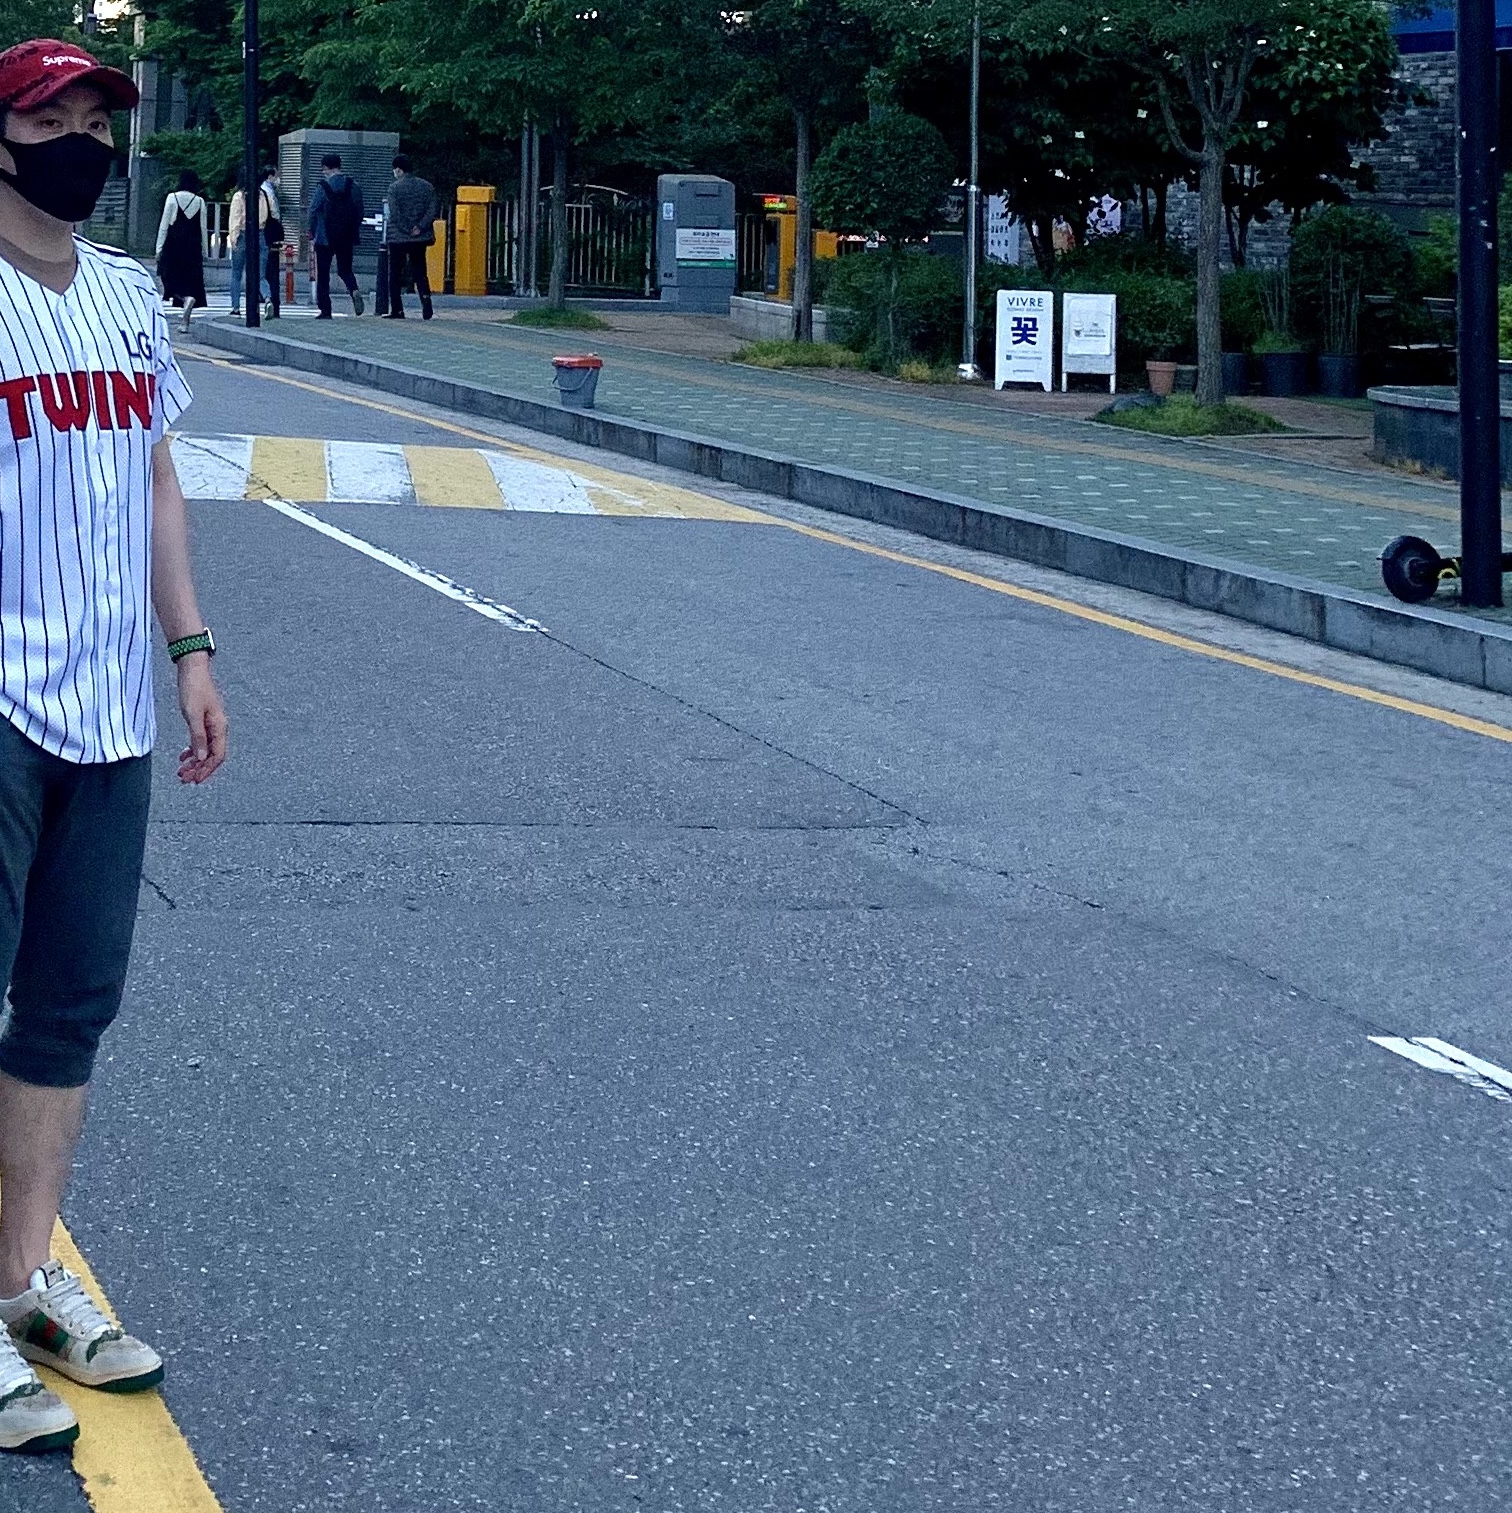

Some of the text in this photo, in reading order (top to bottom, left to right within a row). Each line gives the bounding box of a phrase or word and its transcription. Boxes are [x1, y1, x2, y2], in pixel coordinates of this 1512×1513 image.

[1007, 296, 1044, 307] VIVRE
[120, 330, 152, 360] LG
[1011, 316, 1039, 345] 꽃
